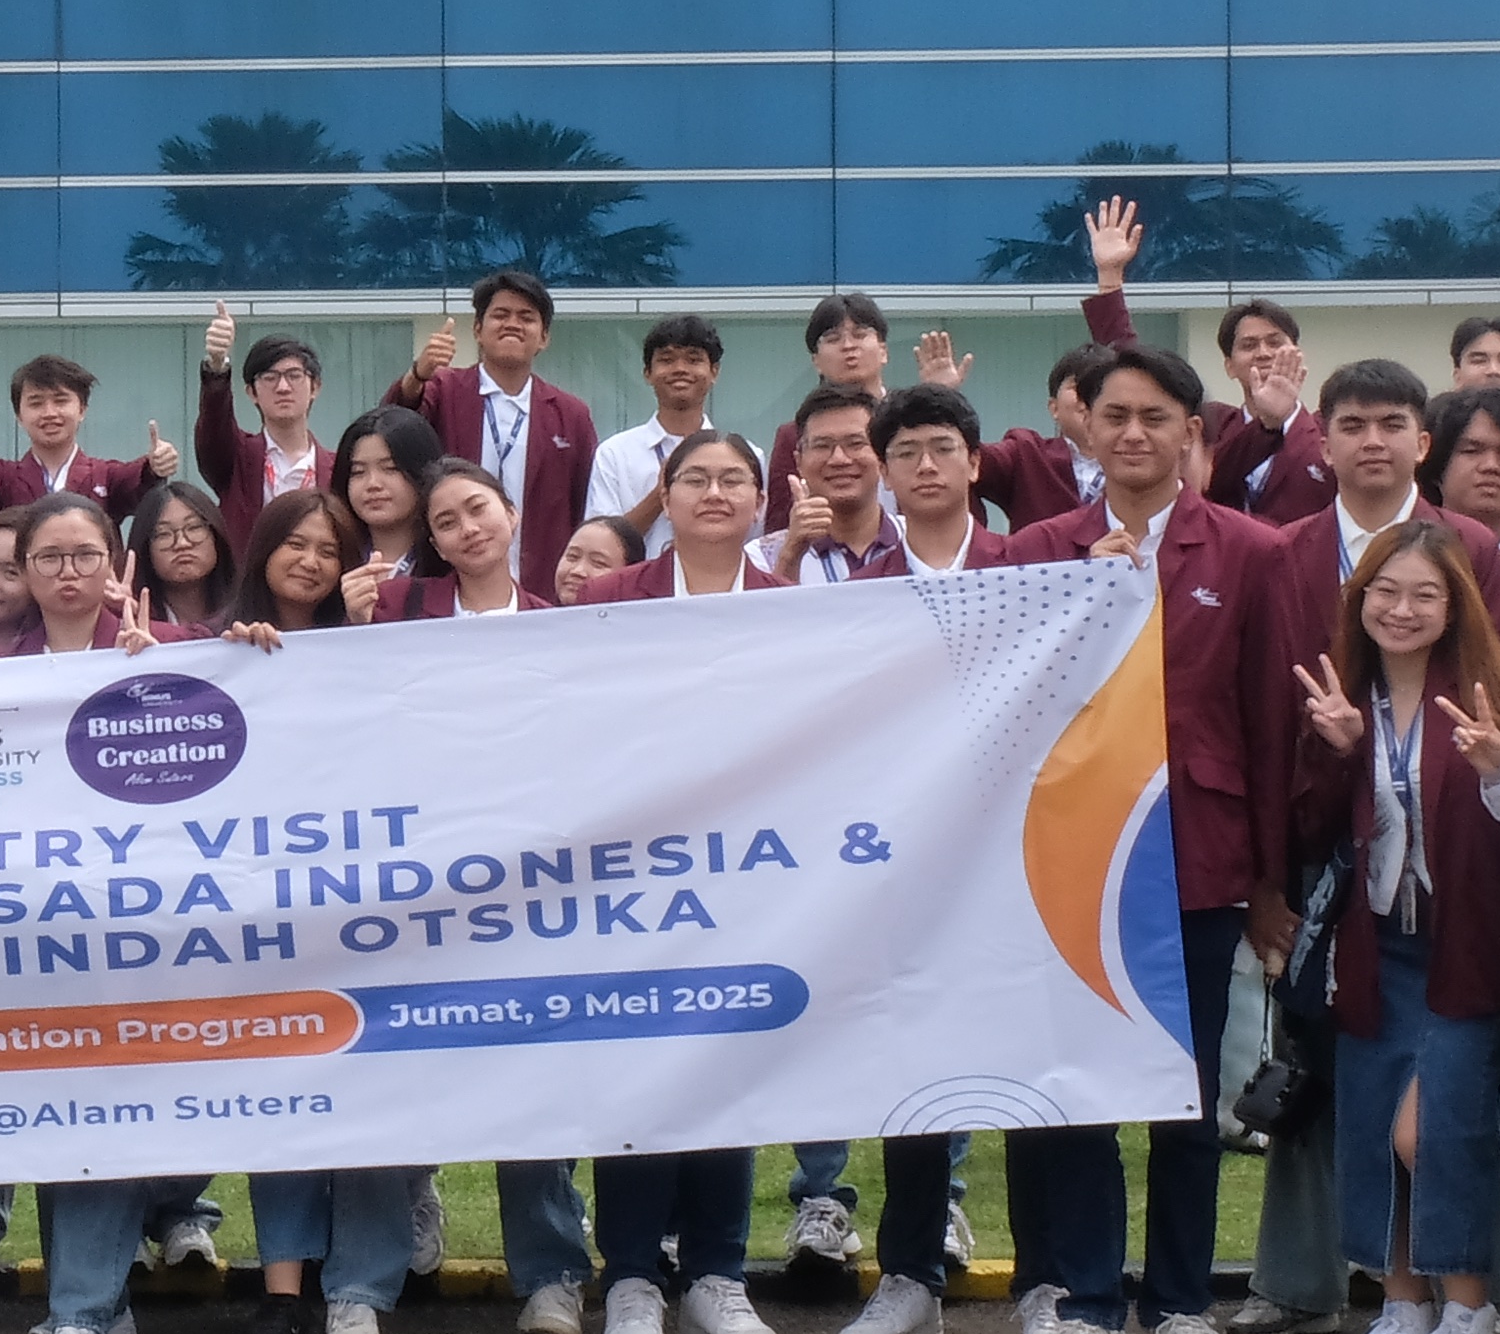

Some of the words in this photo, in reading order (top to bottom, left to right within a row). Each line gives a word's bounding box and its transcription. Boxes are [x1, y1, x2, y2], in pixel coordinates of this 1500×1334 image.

[88, 713, 224, 738] Business
[97, 742, 226, 768] Creation
[182, 805, 419, 858] VISIT
[275, 828, 800, 908] INDONESIA
[839, 822, 892, 864] &
[3, 922, 297, 975] INDAH
[340, 889, 718, 953] OTSUKA
[389, 997, 534, 1027] Jumat,
[546, 995, 571, 1018] 9
[586, 987, 659, 1016] Mei
[673, 984, 772, 1012] 2025
[118, 1013, 324, 1046] Program
[174, 1093, 333, 1121] Sutera
